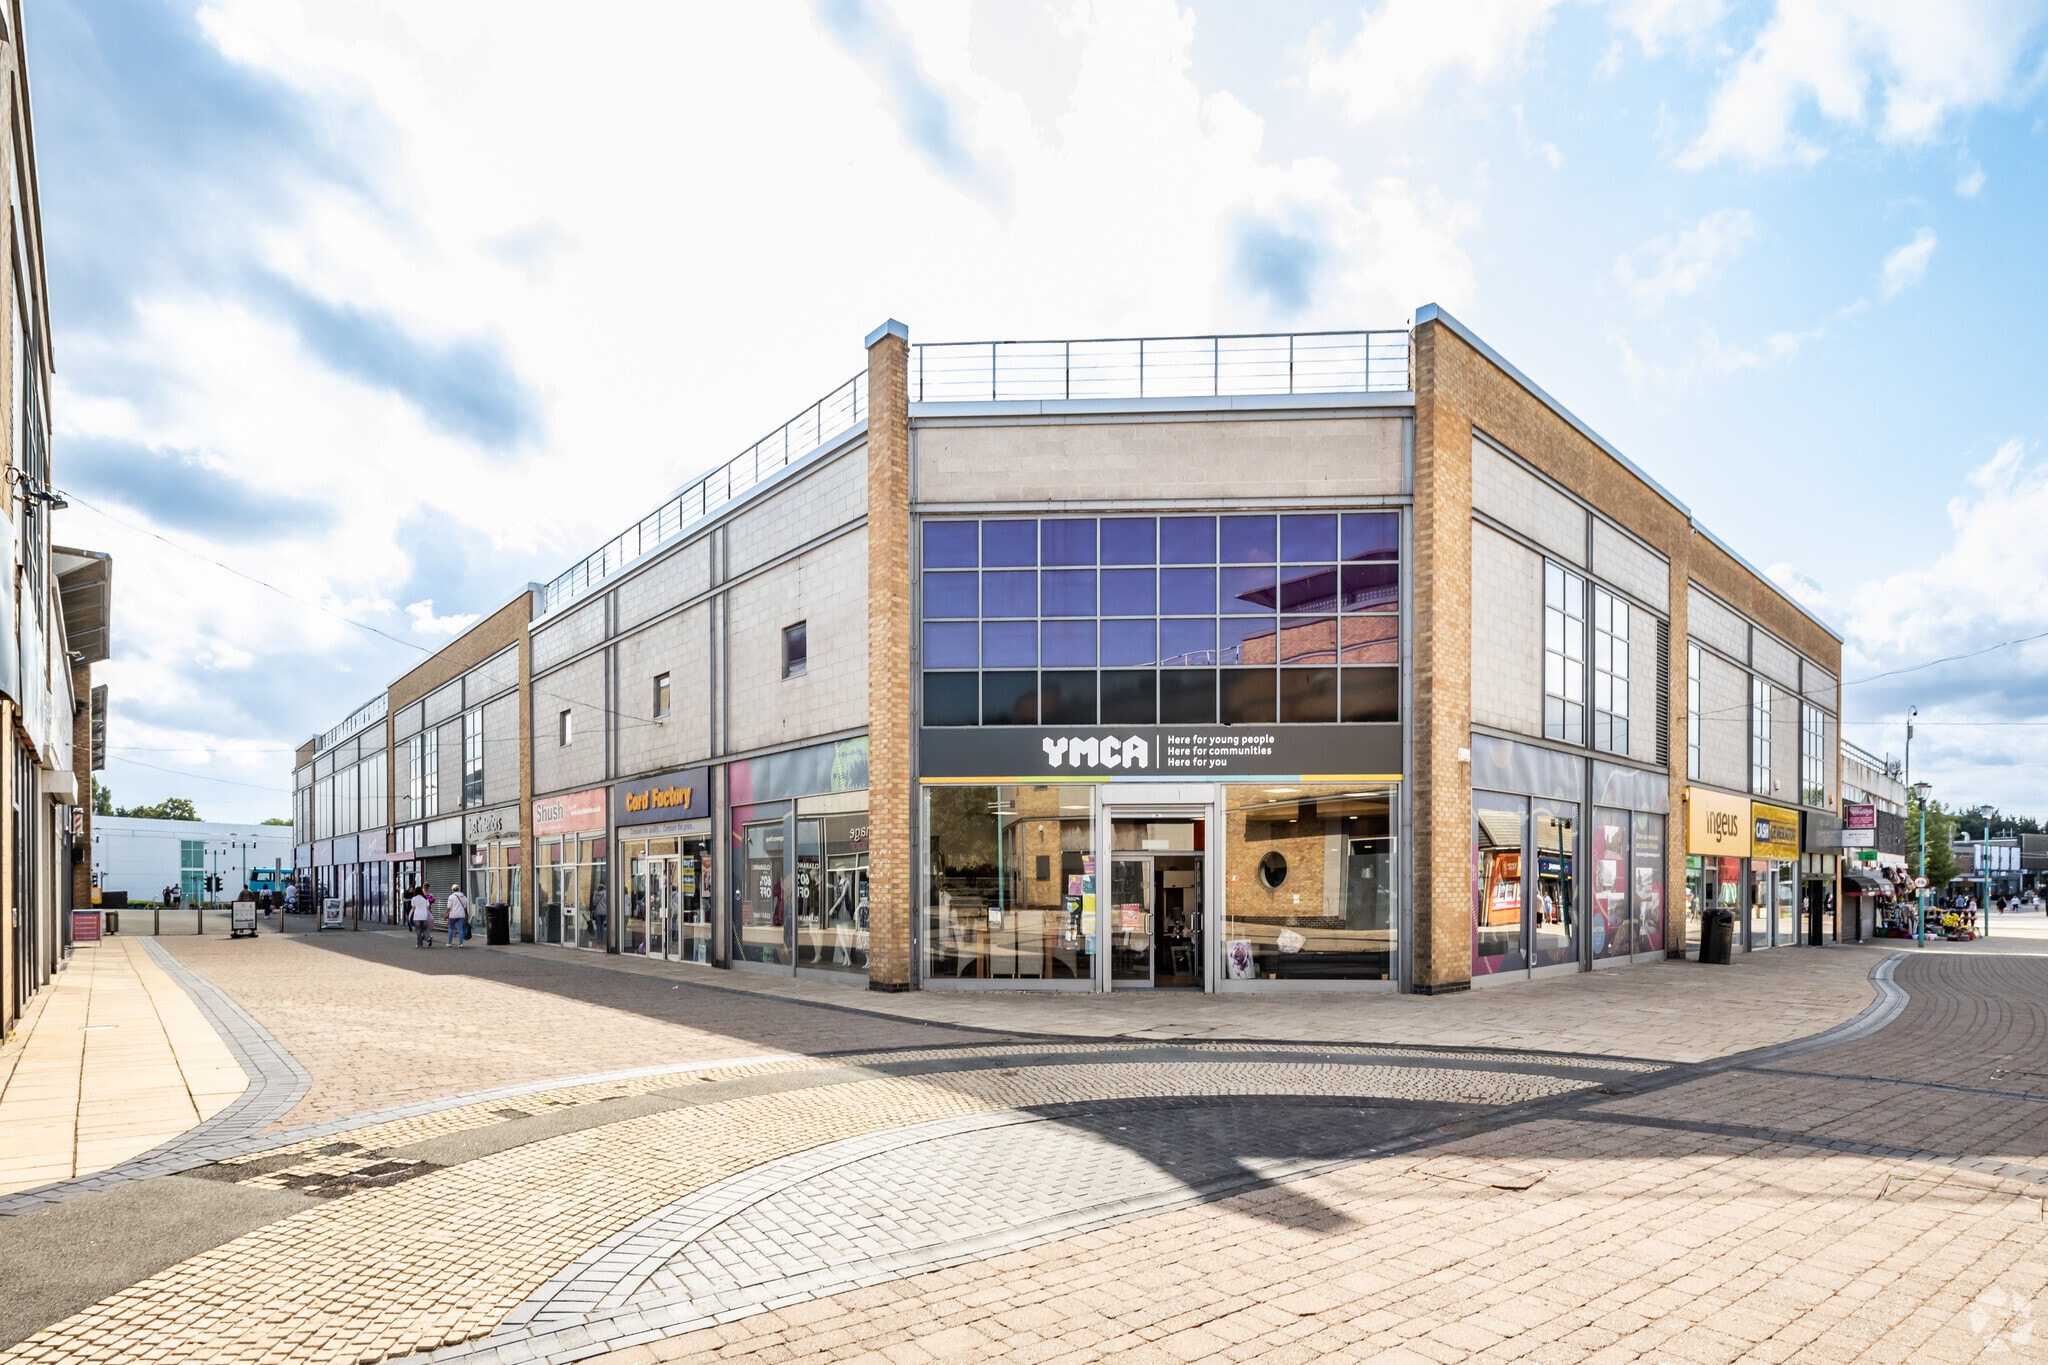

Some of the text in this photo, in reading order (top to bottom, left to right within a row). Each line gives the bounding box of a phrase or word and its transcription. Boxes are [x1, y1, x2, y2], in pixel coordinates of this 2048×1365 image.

[1042, 734, 1148, 769] YMCA
[1168, 734, 1275, 748] Here for young people
[1168, 745, 1272, 756] Here for communities
[1168, 757, 1228, 768] Here for you
[625, 789, 649, 812] Card
[651, 785, 692, 810] Factory
[536, 800, 564, 823] Shush
[1706, 803, 1738, 843] ingeus
[1756, 822, 1796, 841] CASH GENERATOR
